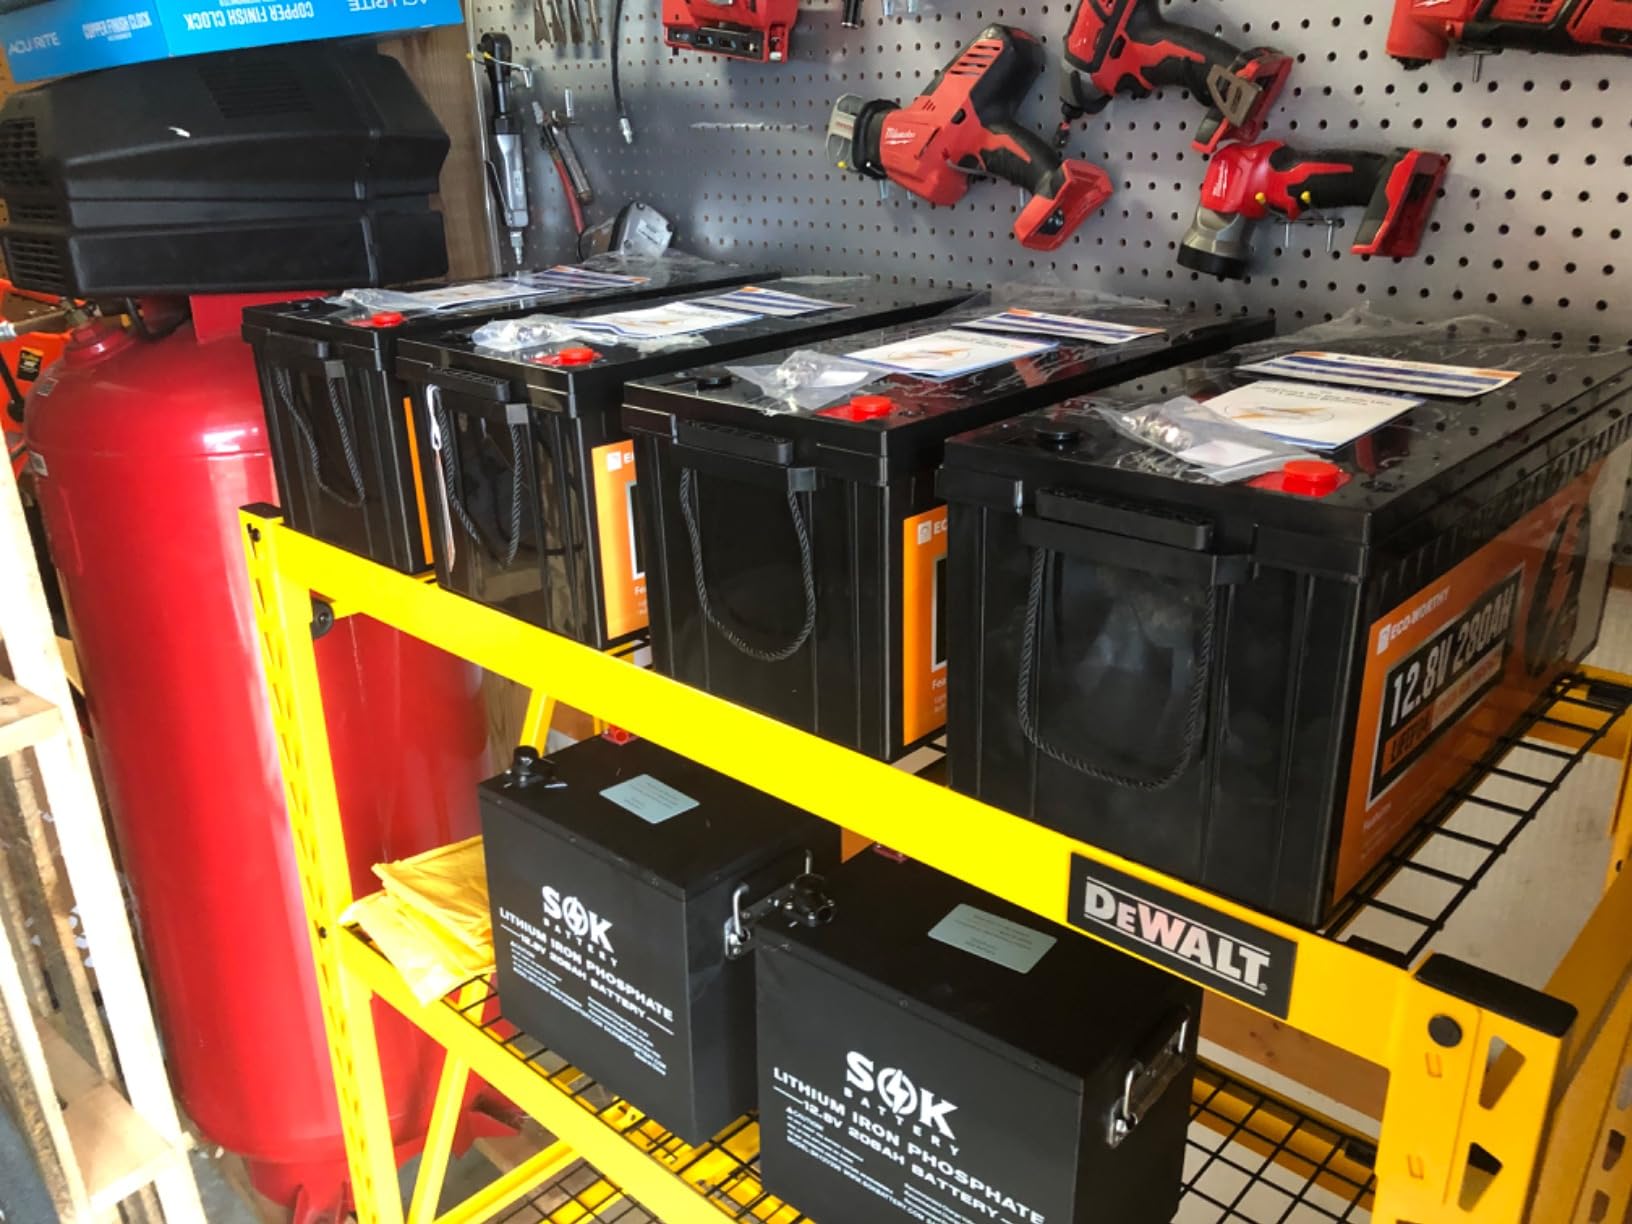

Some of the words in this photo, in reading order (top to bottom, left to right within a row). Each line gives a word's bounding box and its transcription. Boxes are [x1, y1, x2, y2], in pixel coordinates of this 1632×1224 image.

[184, 11, 226, 31] CLOCK
[229, 5, 268, 26] FINISH
[270, 1, 314, 20] COPPER
[1390, 633, 1453, 727] 12.8V
[1452, 582, 1515, 675] 280AH
[541, 885, 615, 954] SOK
[543, 917, 618, 967] BATTERY
[499, 906, 547, 943] LITHIUM
[550, 937, 603, 966] IRON
[586, 958, 675, 1023] PHOSPHATE
[590, 977, 646, 1019] BATTERY
[843, 1086, 959, 1156] BATTERY
[846, 1050, 958, 1140] SOK
[773, 1066, 846, 1117] LITHIUM
[852, 1111, 900, 1147] IRON
[907, 1141, 1046, 1224] PHOSPHATE
[803, 1100, 843, 1128] 12.8V
[911, 1163, 999, 1219] BATTERY
